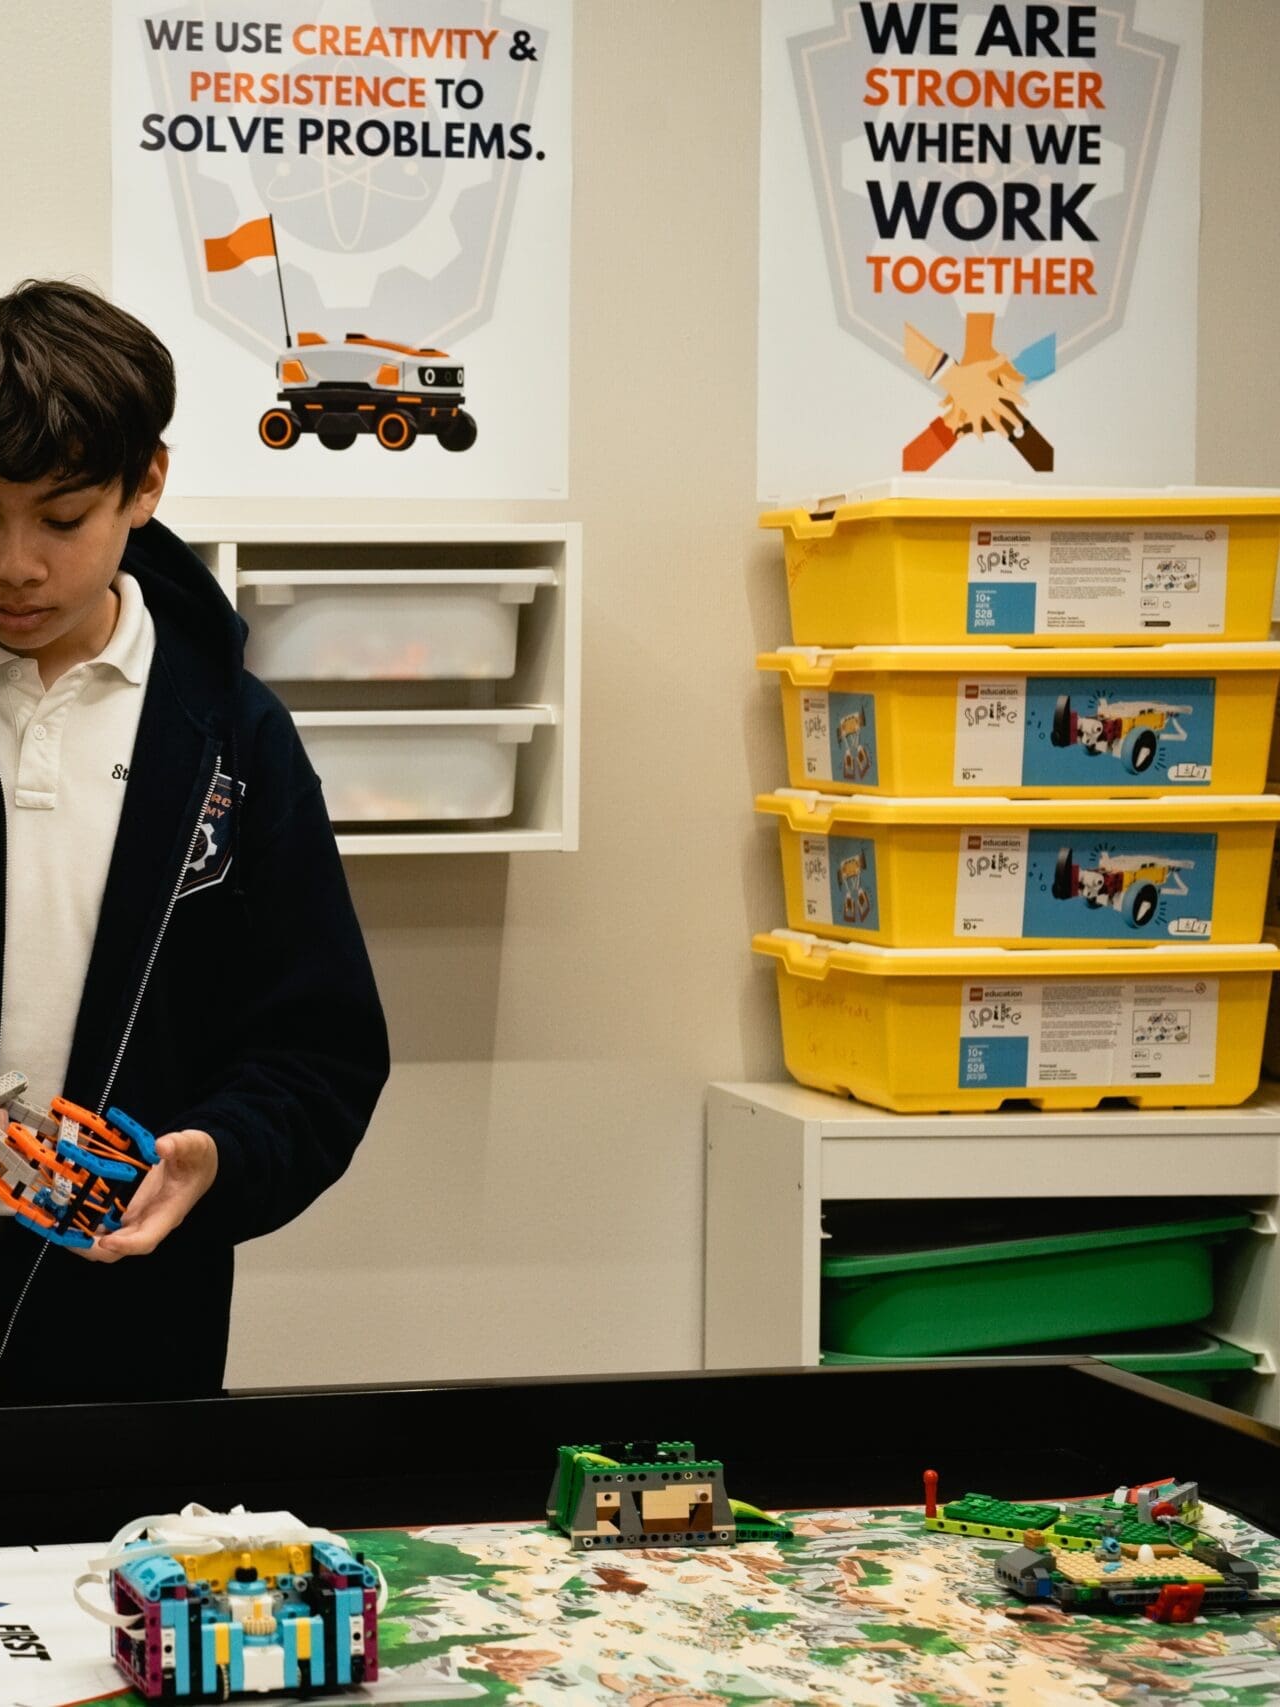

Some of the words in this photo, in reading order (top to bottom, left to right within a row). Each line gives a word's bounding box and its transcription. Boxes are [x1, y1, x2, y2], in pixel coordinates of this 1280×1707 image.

[859, 2, 957, 56] WE
[975, 4, 1096, 58] ARE
[144, 19, 203, 51] WE
[215, 21, 282, 54] USE
[292, 24, 498, 60] CREATIVITY
[508, 30, 538, 61] &
[190, 71, 425, 108] PERSISTENCE
[435, 78, 484, 110] TO
[863, 67, 1106, 110] STRONGER
[140, 113, 284, 154] SOLVE
[299, 118, 545, 161] PROBLEMS.
[864, 121, 1011, 164] WHEN
[1025, 124, 1101, 165] WE
[866, 179, 1099, 242] WORK
[866, 255, 1097, 296] TOGETHER
[992, 534, 1031, 543] education
[975, 594, 991, 602] 10+
[975, 609, 993, 619] 528
[980, 687, 1018, 696] education
[111, 764, 130, 781] St
[204, 805, 226, 819] MY
[982, 838, 1021, 847] education
[984, 990, 1022, 998] education
[968, 1049, 983, 1057] 10+
[967, 1063, 985, 1072] 528
